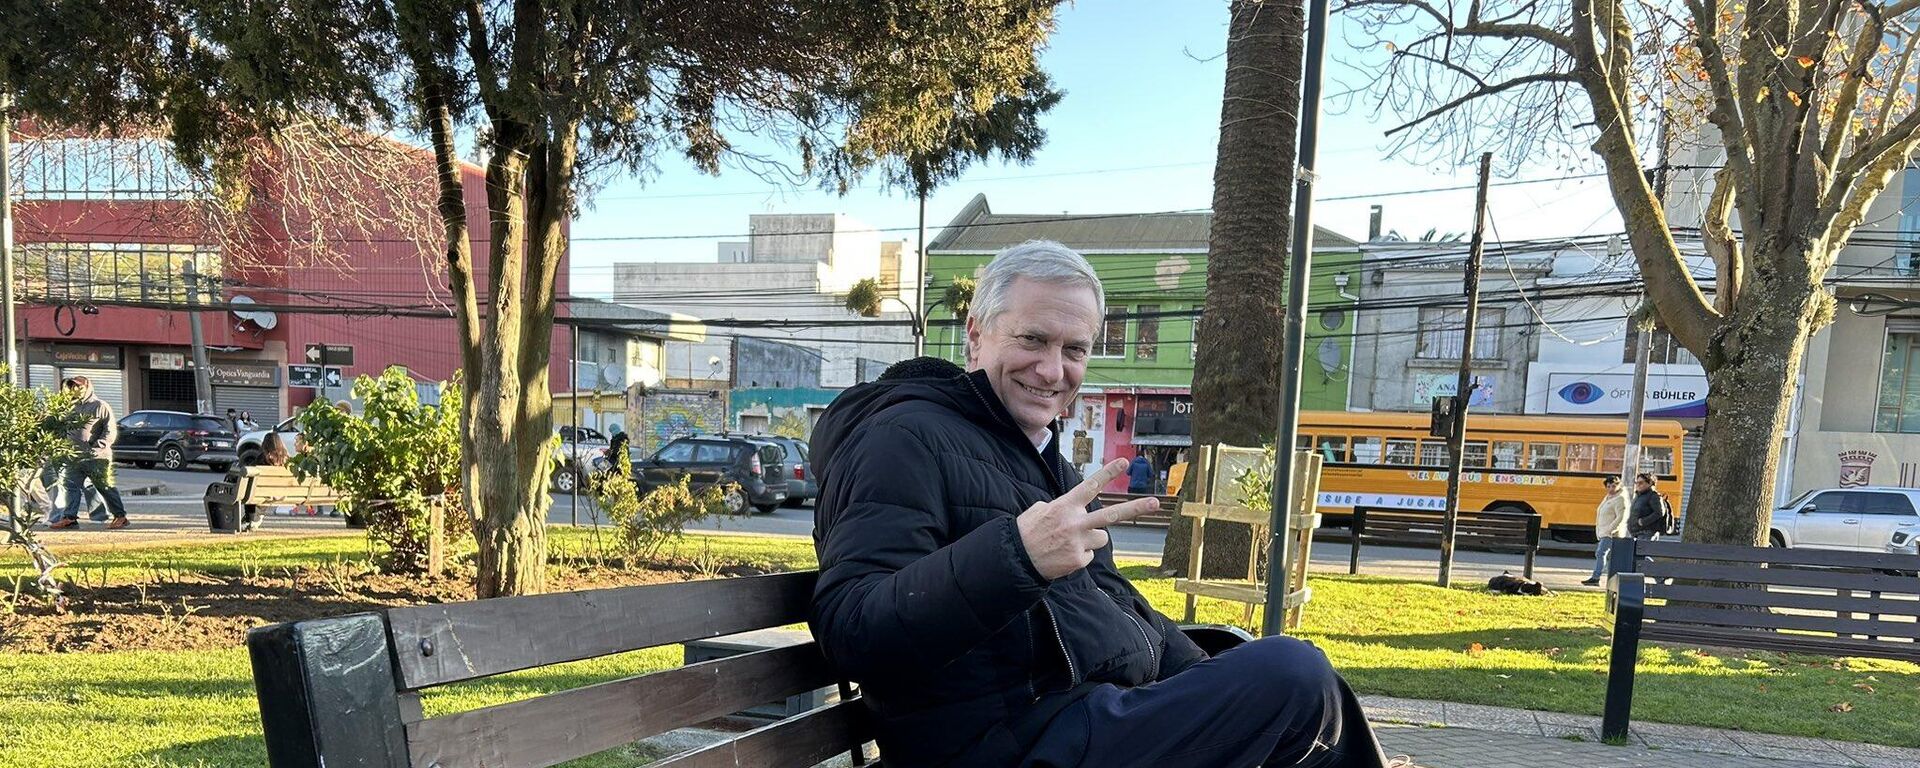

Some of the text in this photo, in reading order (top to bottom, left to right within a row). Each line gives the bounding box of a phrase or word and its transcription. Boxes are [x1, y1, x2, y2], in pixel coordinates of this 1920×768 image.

[1652, 388, 1696, 400] BÜHLER
[1417, 470, 1429, 480] EL
[1488, 473, 1547, 485] SENSORIAL
[1376, 497, 1384, 505] A
[1397, 497, 1446, 508] JUGAR
